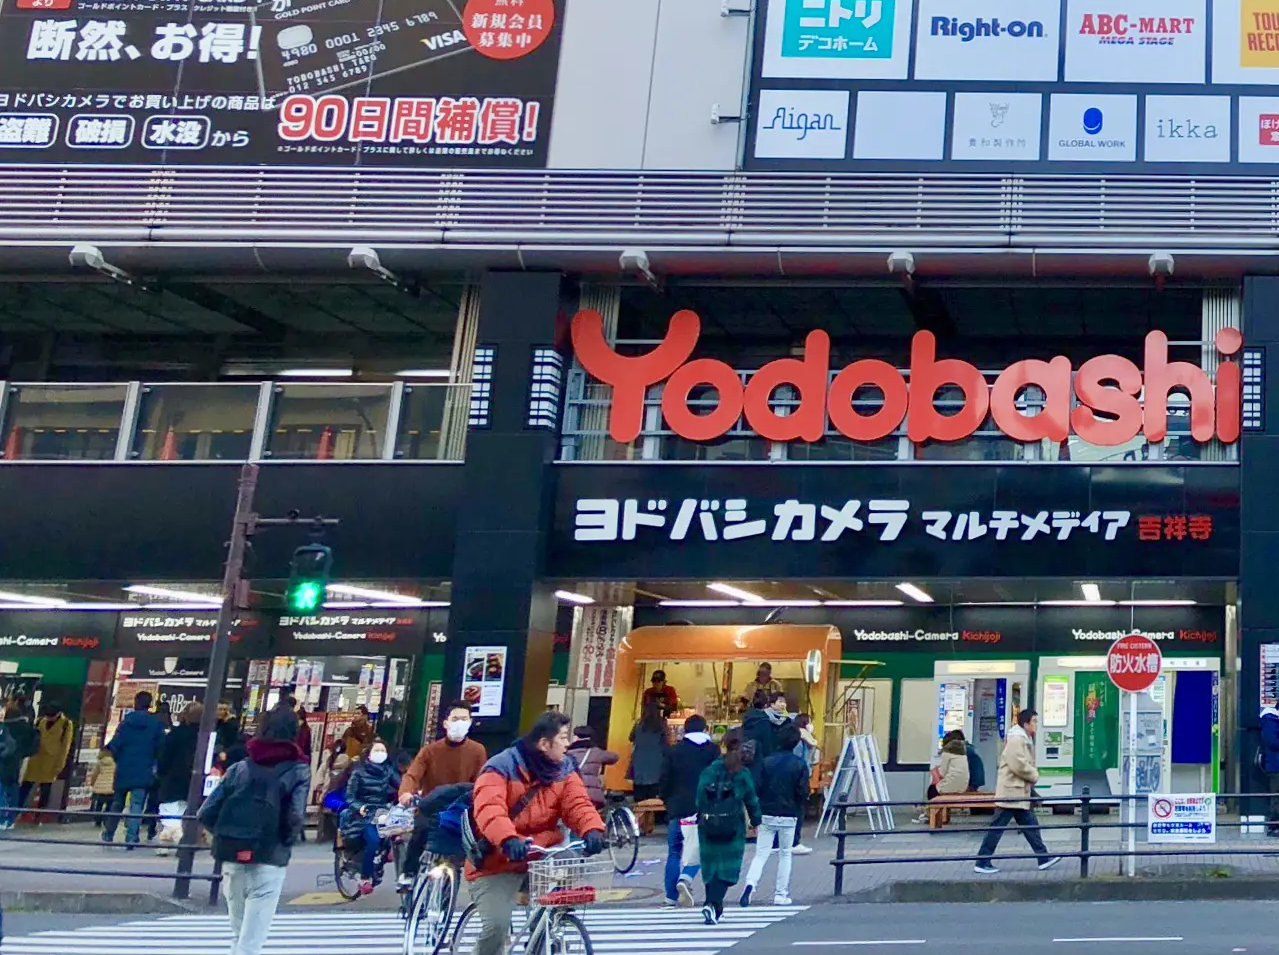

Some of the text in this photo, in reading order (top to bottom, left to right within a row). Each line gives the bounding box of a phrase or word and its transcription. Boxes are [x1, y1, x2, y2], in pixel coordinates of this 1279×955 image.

[274, 8, 300, 21] GOLD
[300, 2, 327, 15] POINT
[470, 12, 544, 30] 新規会員
[930, 15, 1044, 42] Right-on
[1078, 12, 1195, 36] ABC-MART
[26, 18, 263, 64] 断然、お得!
[281, 43, 318, 61] 4980
[324, 31, 361, 50] 0001
[366, 20, 400, 38] 2345
[423, 28, 468, 51] VISA
[477, 31, 532, 49] 募集中
[798, 34, 879, 52] デコホーム
[1098, 35, 1175, 46] MEGA STAGE
[277, 94, 540, 145] 90日間補償!
[762, 105, 842, 141] Aigan
[1156, 118, 1219, 139] ikka
[74, 118, 128, 144] 破損
[149, 119, 250, 148] 水没 から
[1058, 139, 1126, 148] GLOBAL WORK
[570, 307, 1244, 446] Yodobashi
[574, 497, 1214, 542] ヨドバシカメラ マルチメディア 吉祥寺
[123, 616, 195, 628] ヨドバシカメラ
[279, 615, 350, 626] ヨドバシカメラ
[853, 628, 1001, 644] Yodobashi-Camera Kichijoji
[1071, 628, 1218, 644] YodobashiCamera Kichijoji
[1116, 642, 1129, 650] FIRE
[1109, 652, 1159, 674] 防火水槽
